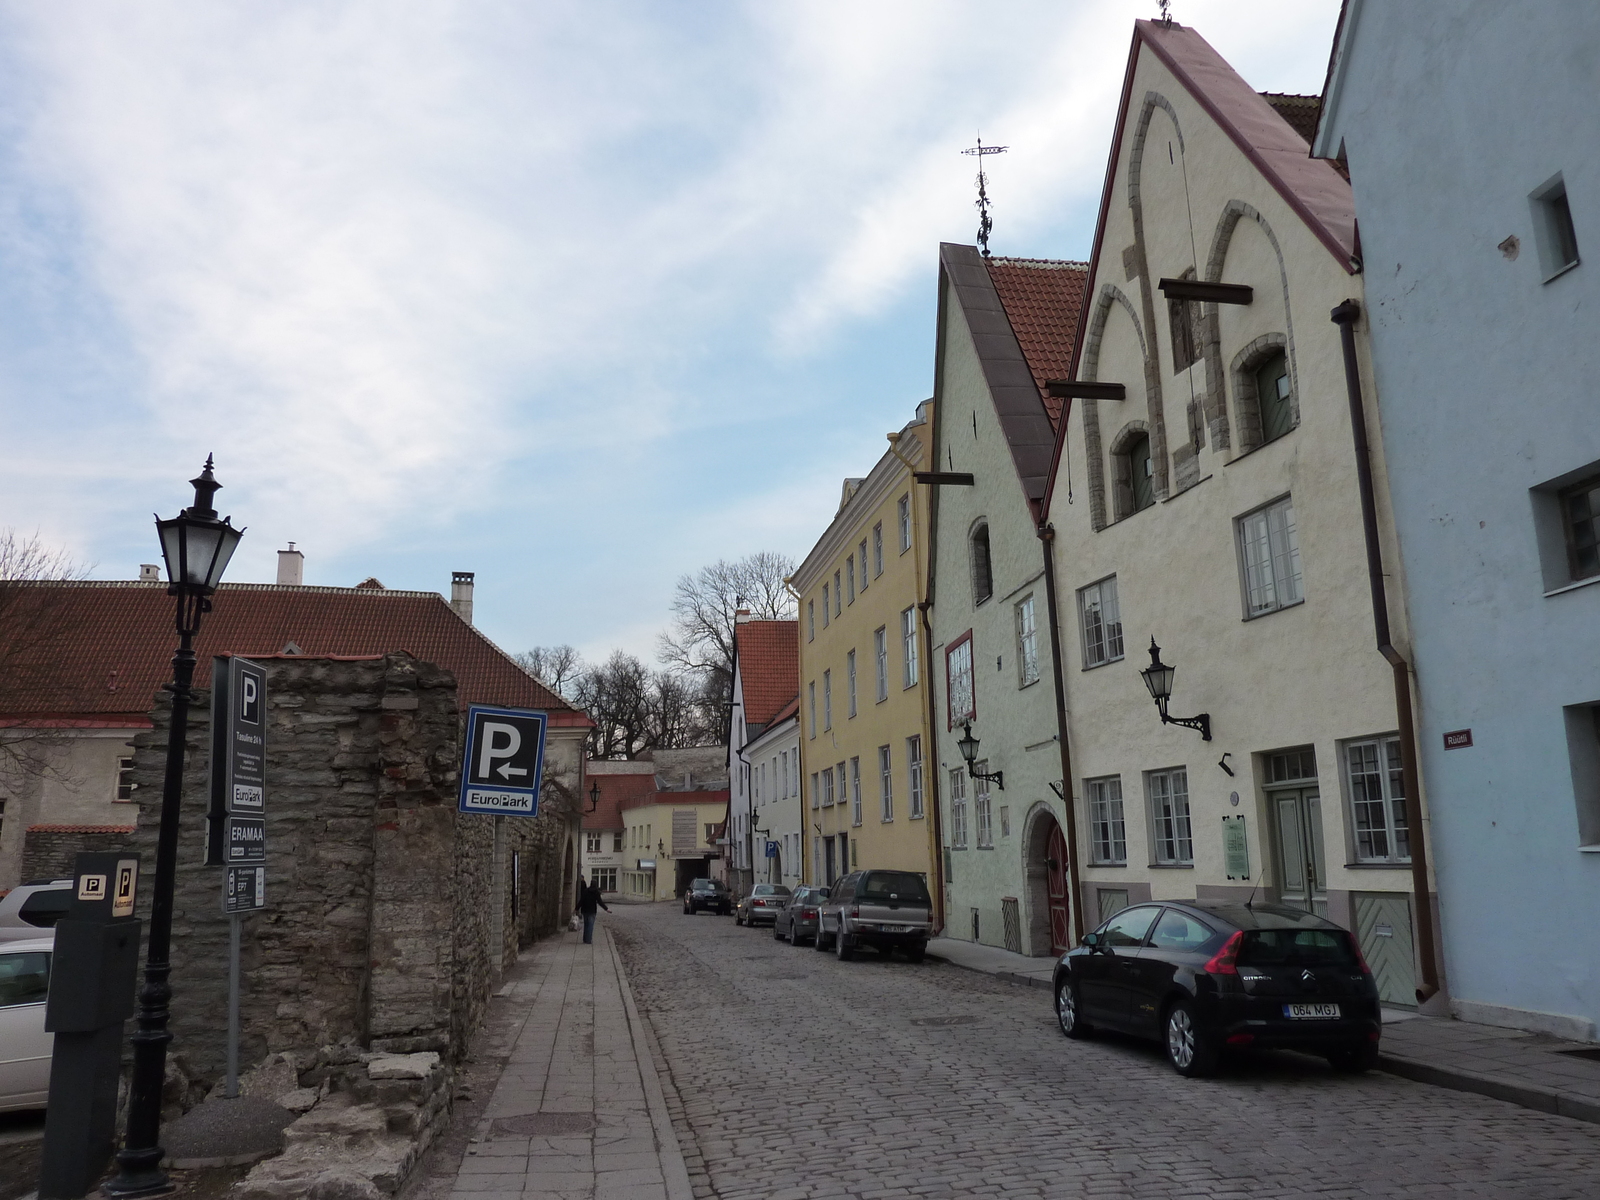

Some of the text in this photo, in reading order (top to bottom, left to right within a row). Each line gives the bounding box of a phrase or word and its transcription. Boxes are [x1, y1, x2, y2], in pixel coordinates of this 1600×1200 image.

[244, 677, 257, 716] P
[478, 721, 522, 779] P
[235, 788, 261, 803] EuroPark
[471, 793, 529, 808] EuroPark
[231, 827, 263, 841] ERAMAA
[767, 843, 774, 852] P
[88, 879, 98, 890] P
[121, 871, 130, 894] P
[237, 882, 247, 892] EP7
[1293, 1004, 1337, 1016] 064 MGJ
